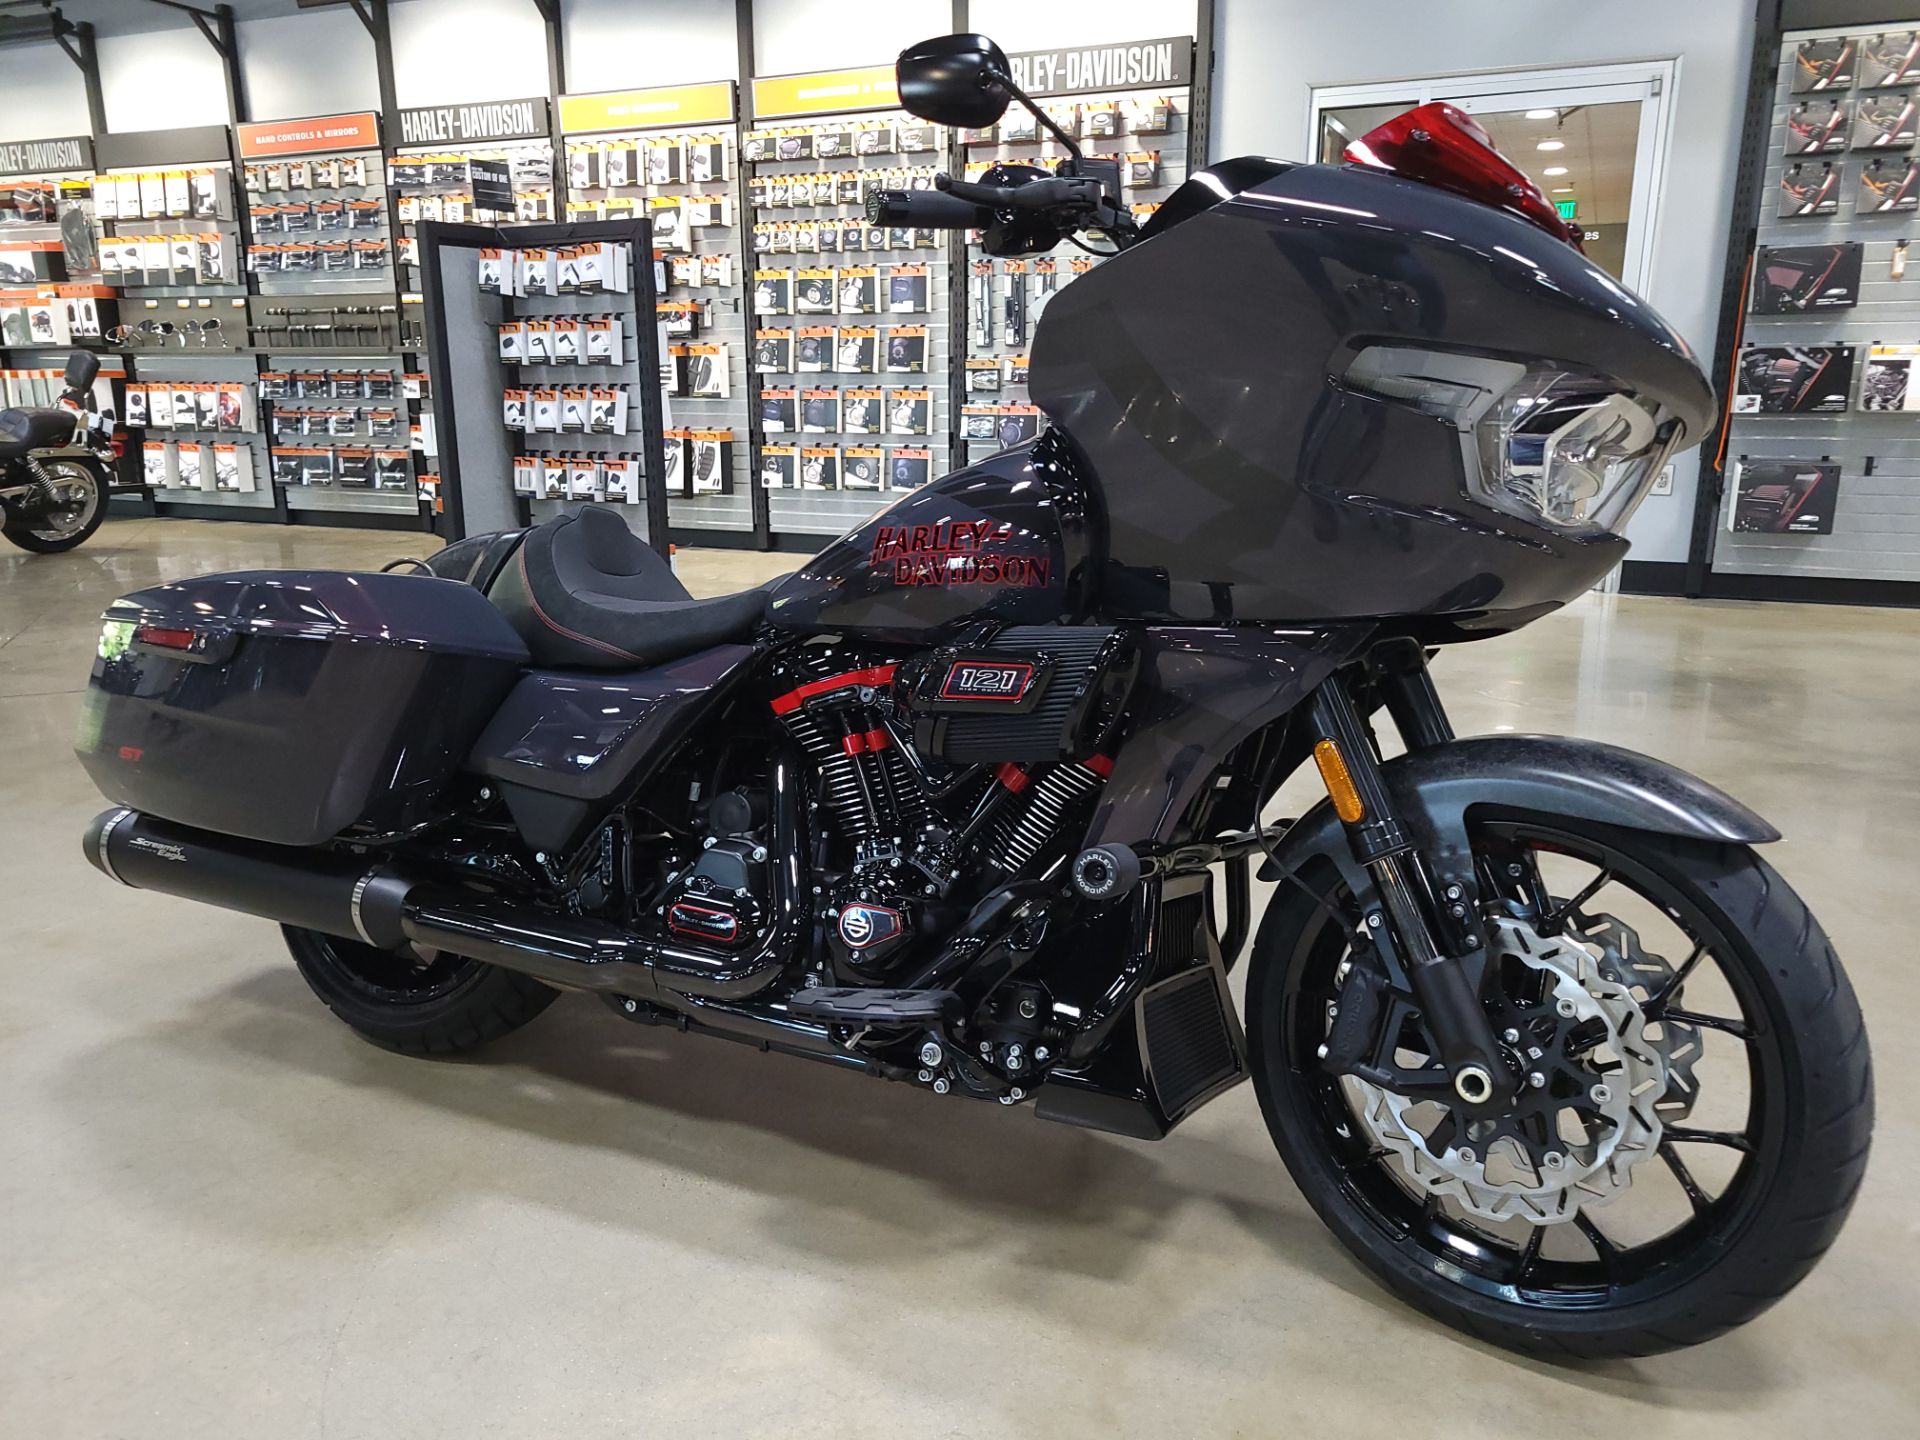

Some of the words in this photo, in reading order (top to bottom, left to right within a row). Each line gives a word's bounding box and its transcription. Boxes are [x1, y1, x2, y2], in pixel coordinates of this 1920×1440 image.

[400, 102, 535, 143] HARLEY-DAVIDSON
[255, 136, 276, 145] HAND
[277, 131, 315, 142] CONTROLS
[316, 130, 323, 139] &
[324, 127, 359, 138] MIRRORS
[895, 553, 1051, 589] DAVIDSON
[960, 668, 1018, 690] 121
[118, 746, 144, 761] ST
[156, 849, 188, 862] Eagle
[1080, 853, 1113, 869] HARLEY
[1075, 873, 1113, 895] DAVIDSON
